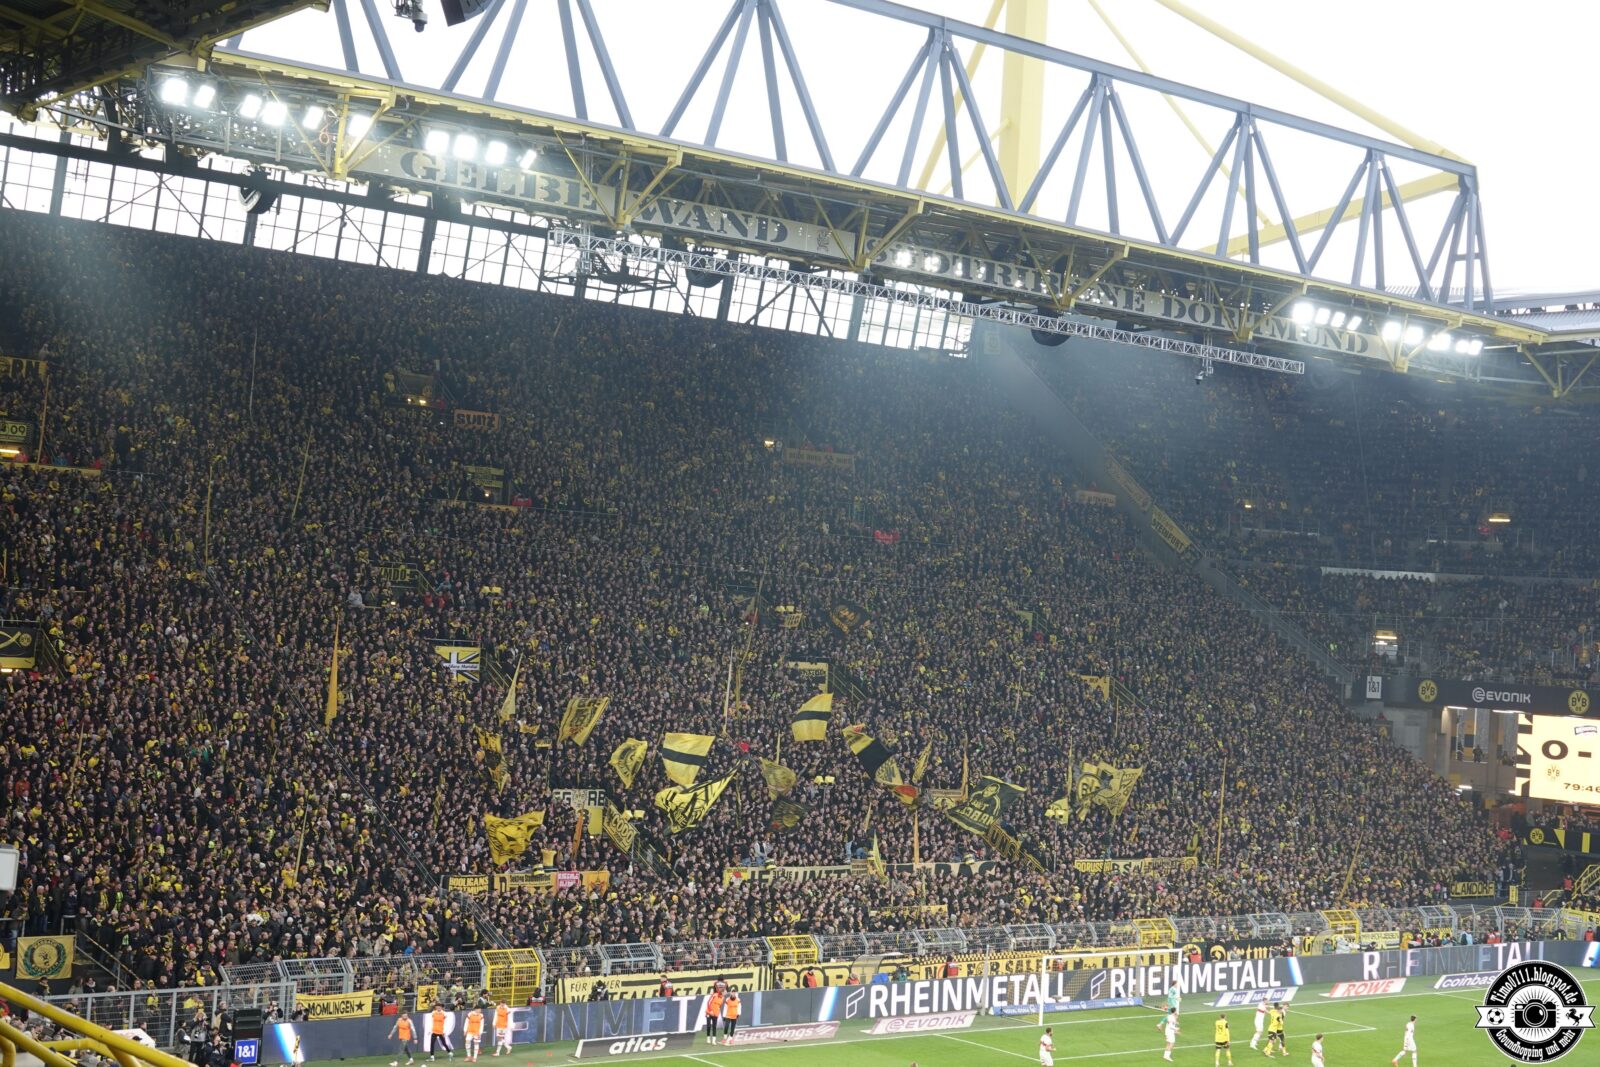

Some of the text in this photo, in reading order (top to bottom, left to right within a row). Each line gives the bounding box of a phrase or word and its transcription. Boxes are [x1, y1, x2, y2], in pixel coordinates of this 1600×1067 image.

[400, 149, 598, 212] GELBE
[636, 192, 789, 245] WAND
[1161, 298, 1370, 354] DORTMUND
[1420, 682, 1437, 697] BVB
[1571, 691, 1588, 708] BVB
[1109, 958, 1282, 999] RHEINMETALL
[1343, 980, 1395, 995] ROWE
[1442, 971, 1496, 988] coinbas
[869, 971, 1071, 1019] RHEINMETALL
[904, 1013, 967, 1031] EVONIK
[734, 1025, 814, 1043] Eurowings
[236, 1043, 256, 1058] 1&1
[608, 1035, 667, 1056] atlas
